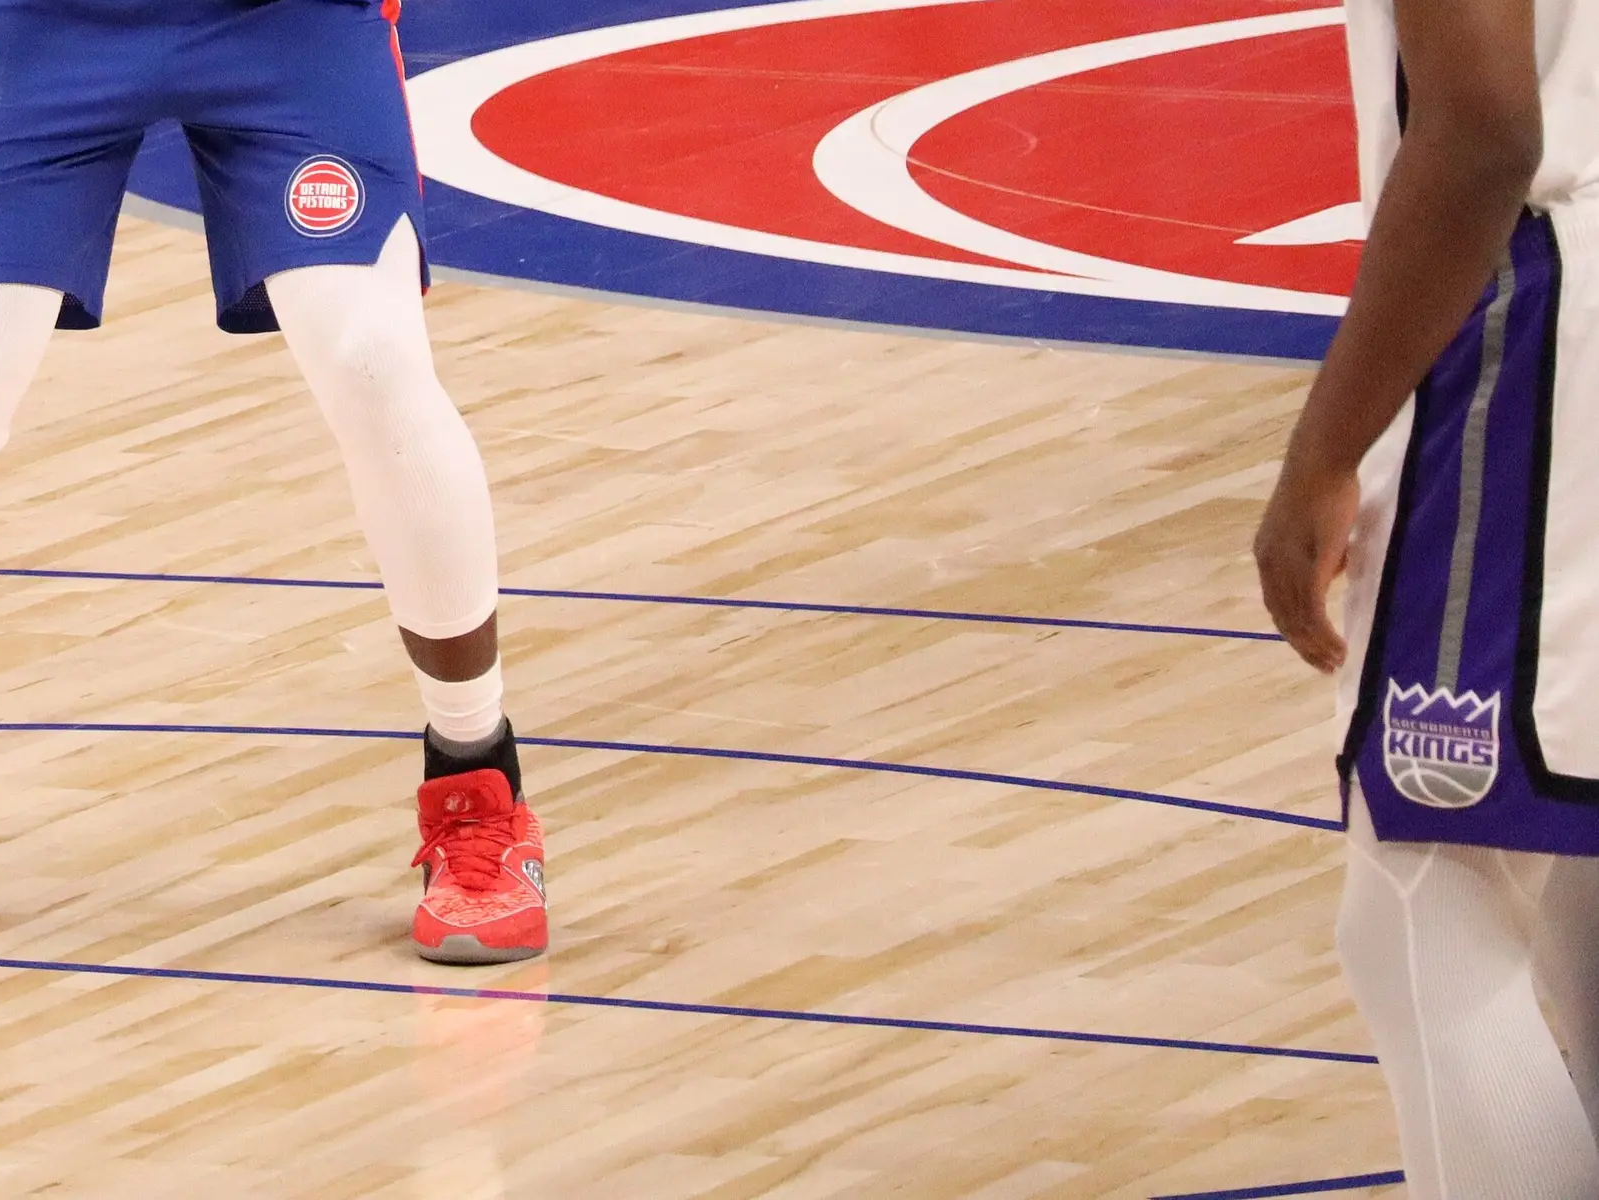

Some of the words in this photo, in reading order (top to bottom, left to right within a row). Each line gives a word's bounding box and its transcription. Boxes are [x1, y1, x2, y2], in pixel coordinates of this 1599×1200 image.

[299, 182, 348, 196] DETROIT
[298, 195, 348, 209] PISTONS
[1391, 717, 1490, 741] SACRAMENTO
[1388, 730, 1494, 767] KINGS
